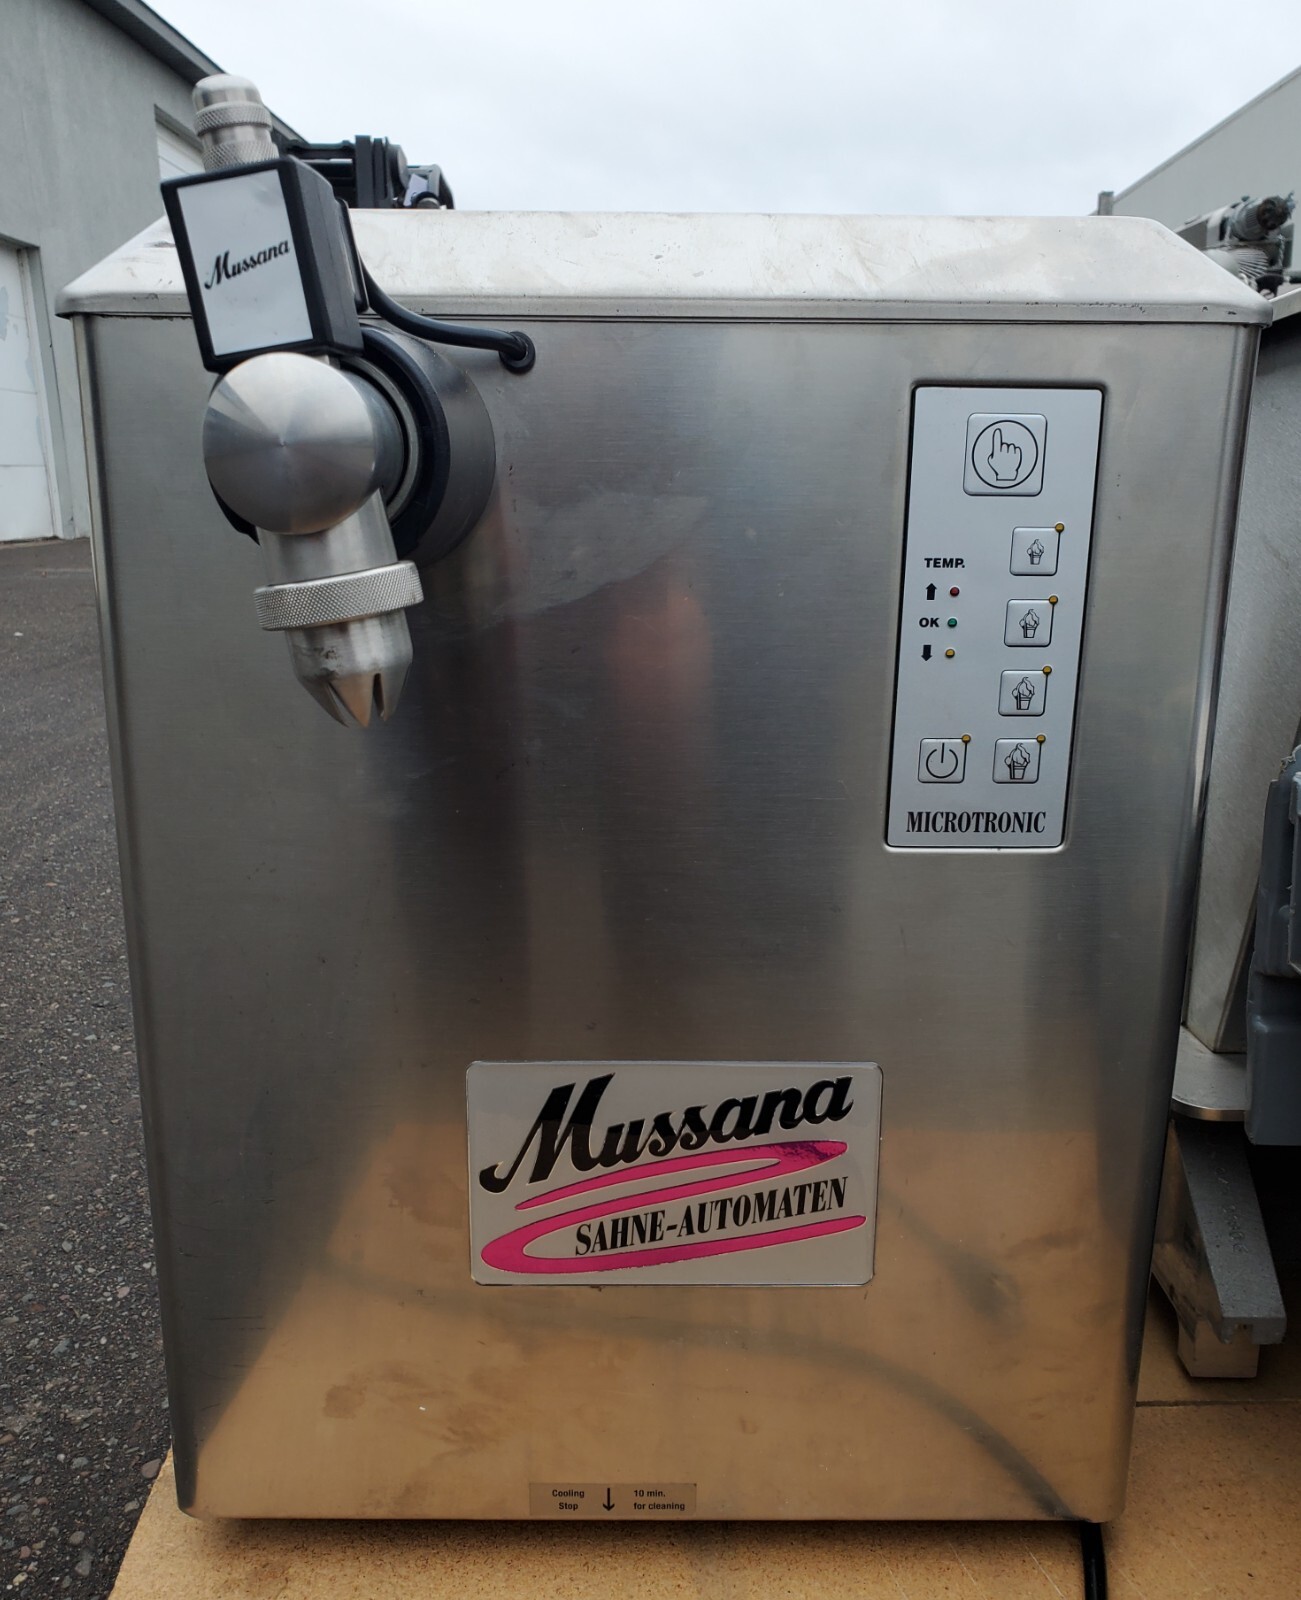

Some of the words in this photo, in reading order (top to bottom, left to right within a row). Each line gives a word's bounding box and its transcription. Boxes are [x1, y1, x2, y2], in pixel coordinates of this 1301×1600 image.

[204, 239, 290, 290] Mussana
[924, 557, 965, 569] TEMP.
[918, 617, 940, 628] OK
[905, 811, 1047, 834] MICROTRONIC
[478, 1072, 854, 1194] Mussana
[575, 1176, 848, 1256] SAHNE-AUTOMATEN
[551, 1489, 585, 1498] Cooling
[633, 1489, 645, 1497] 10
[646, 1489, 666, 1497] min.
[558, 1502, 579, 1511] Stop
[633, 1502, 646, 1510] for
[648, 1502, 686, 1511] cleaning
